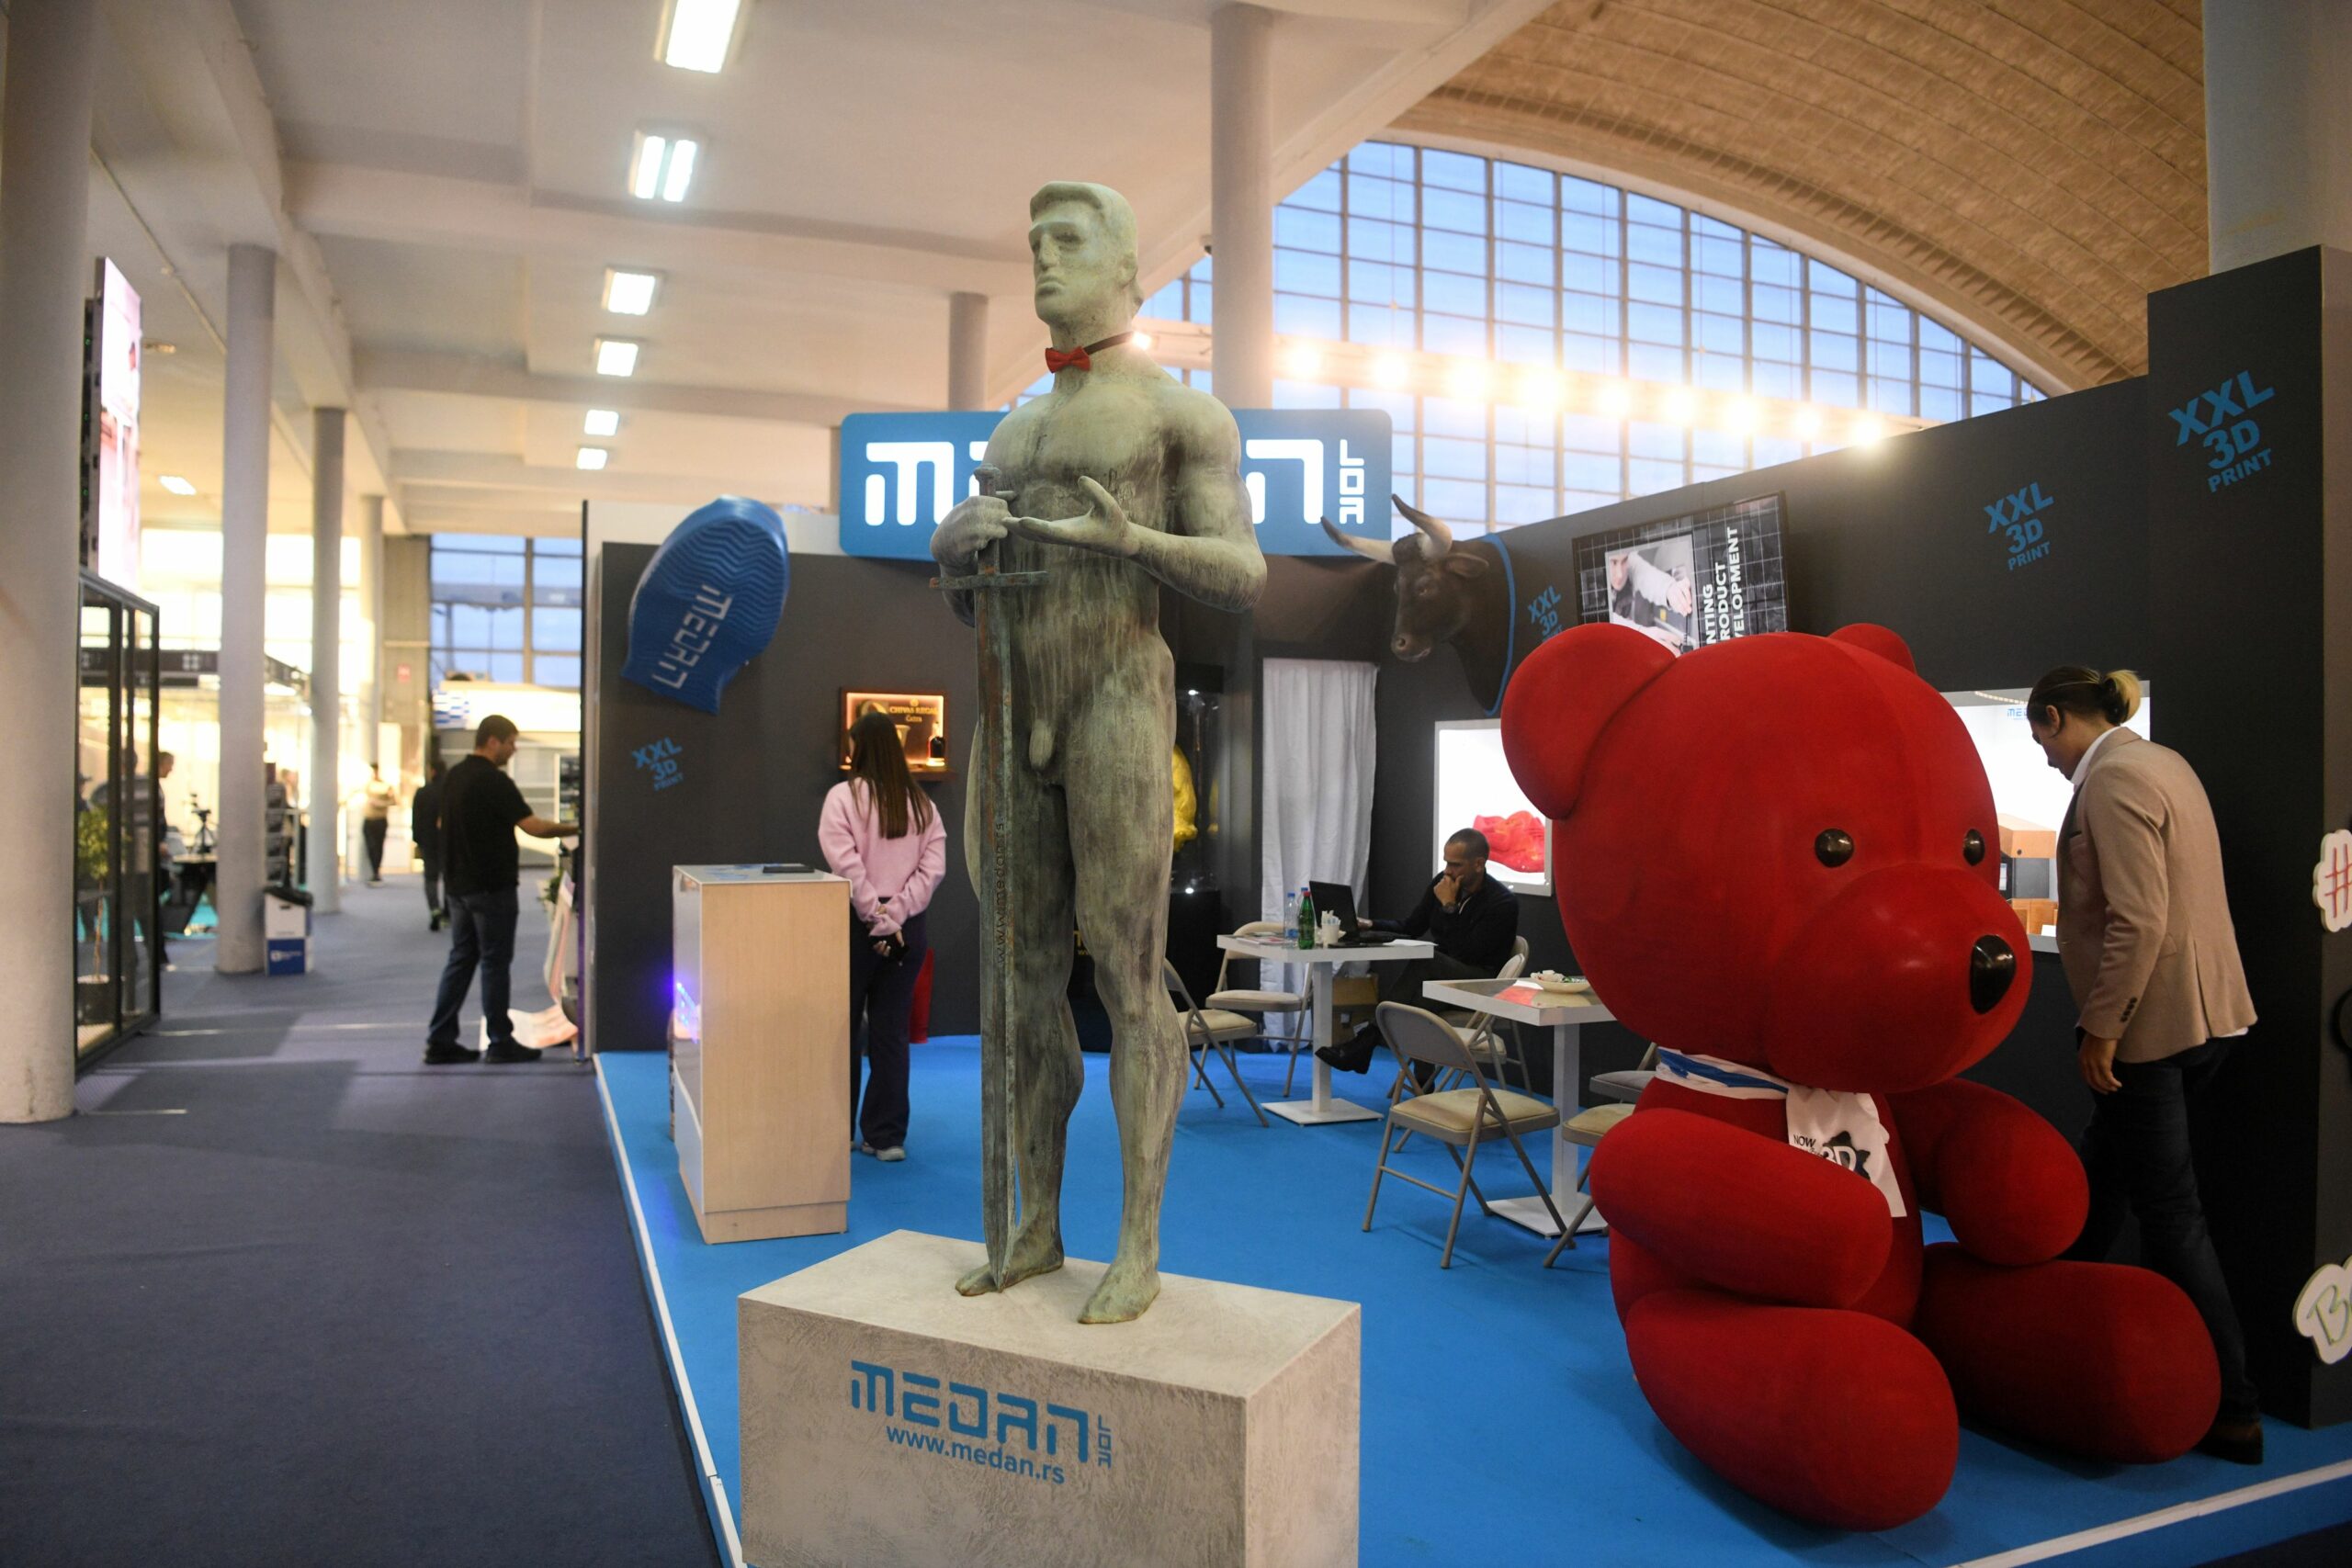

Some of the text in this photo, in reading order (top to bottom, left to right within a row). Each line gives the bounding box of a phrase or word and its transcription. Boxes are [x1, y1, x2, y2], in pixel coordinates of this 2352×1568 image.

[2168, 370, 2276, 446] XXL
[2203, 419, 2260, 469] 3D
[2208, 448, 2271, 492] PRINT
[1984, 482, 2054, 533] XXL
[2007, 518, 2043, 553] 3D
[2008, 541, 2051, 570] PRINT
[1528, 586, 1561, 625] XXL
[1715, 562, 1731, 641] RODUCT
[1727, 527, 1745, 637] ELOPMENT
[1540, 611, 1558, 636] 3D
[1703, 584, 1717, 645] NTING
[632, 737, 683, 768] XXL
[650, 759, 677, 780] 3D
[2306, 1284, 2352, 1346] B
[851, 1359, 1089, 1463] MEDAN
[886, 1426, 1065, 1484] www.medan.rs
